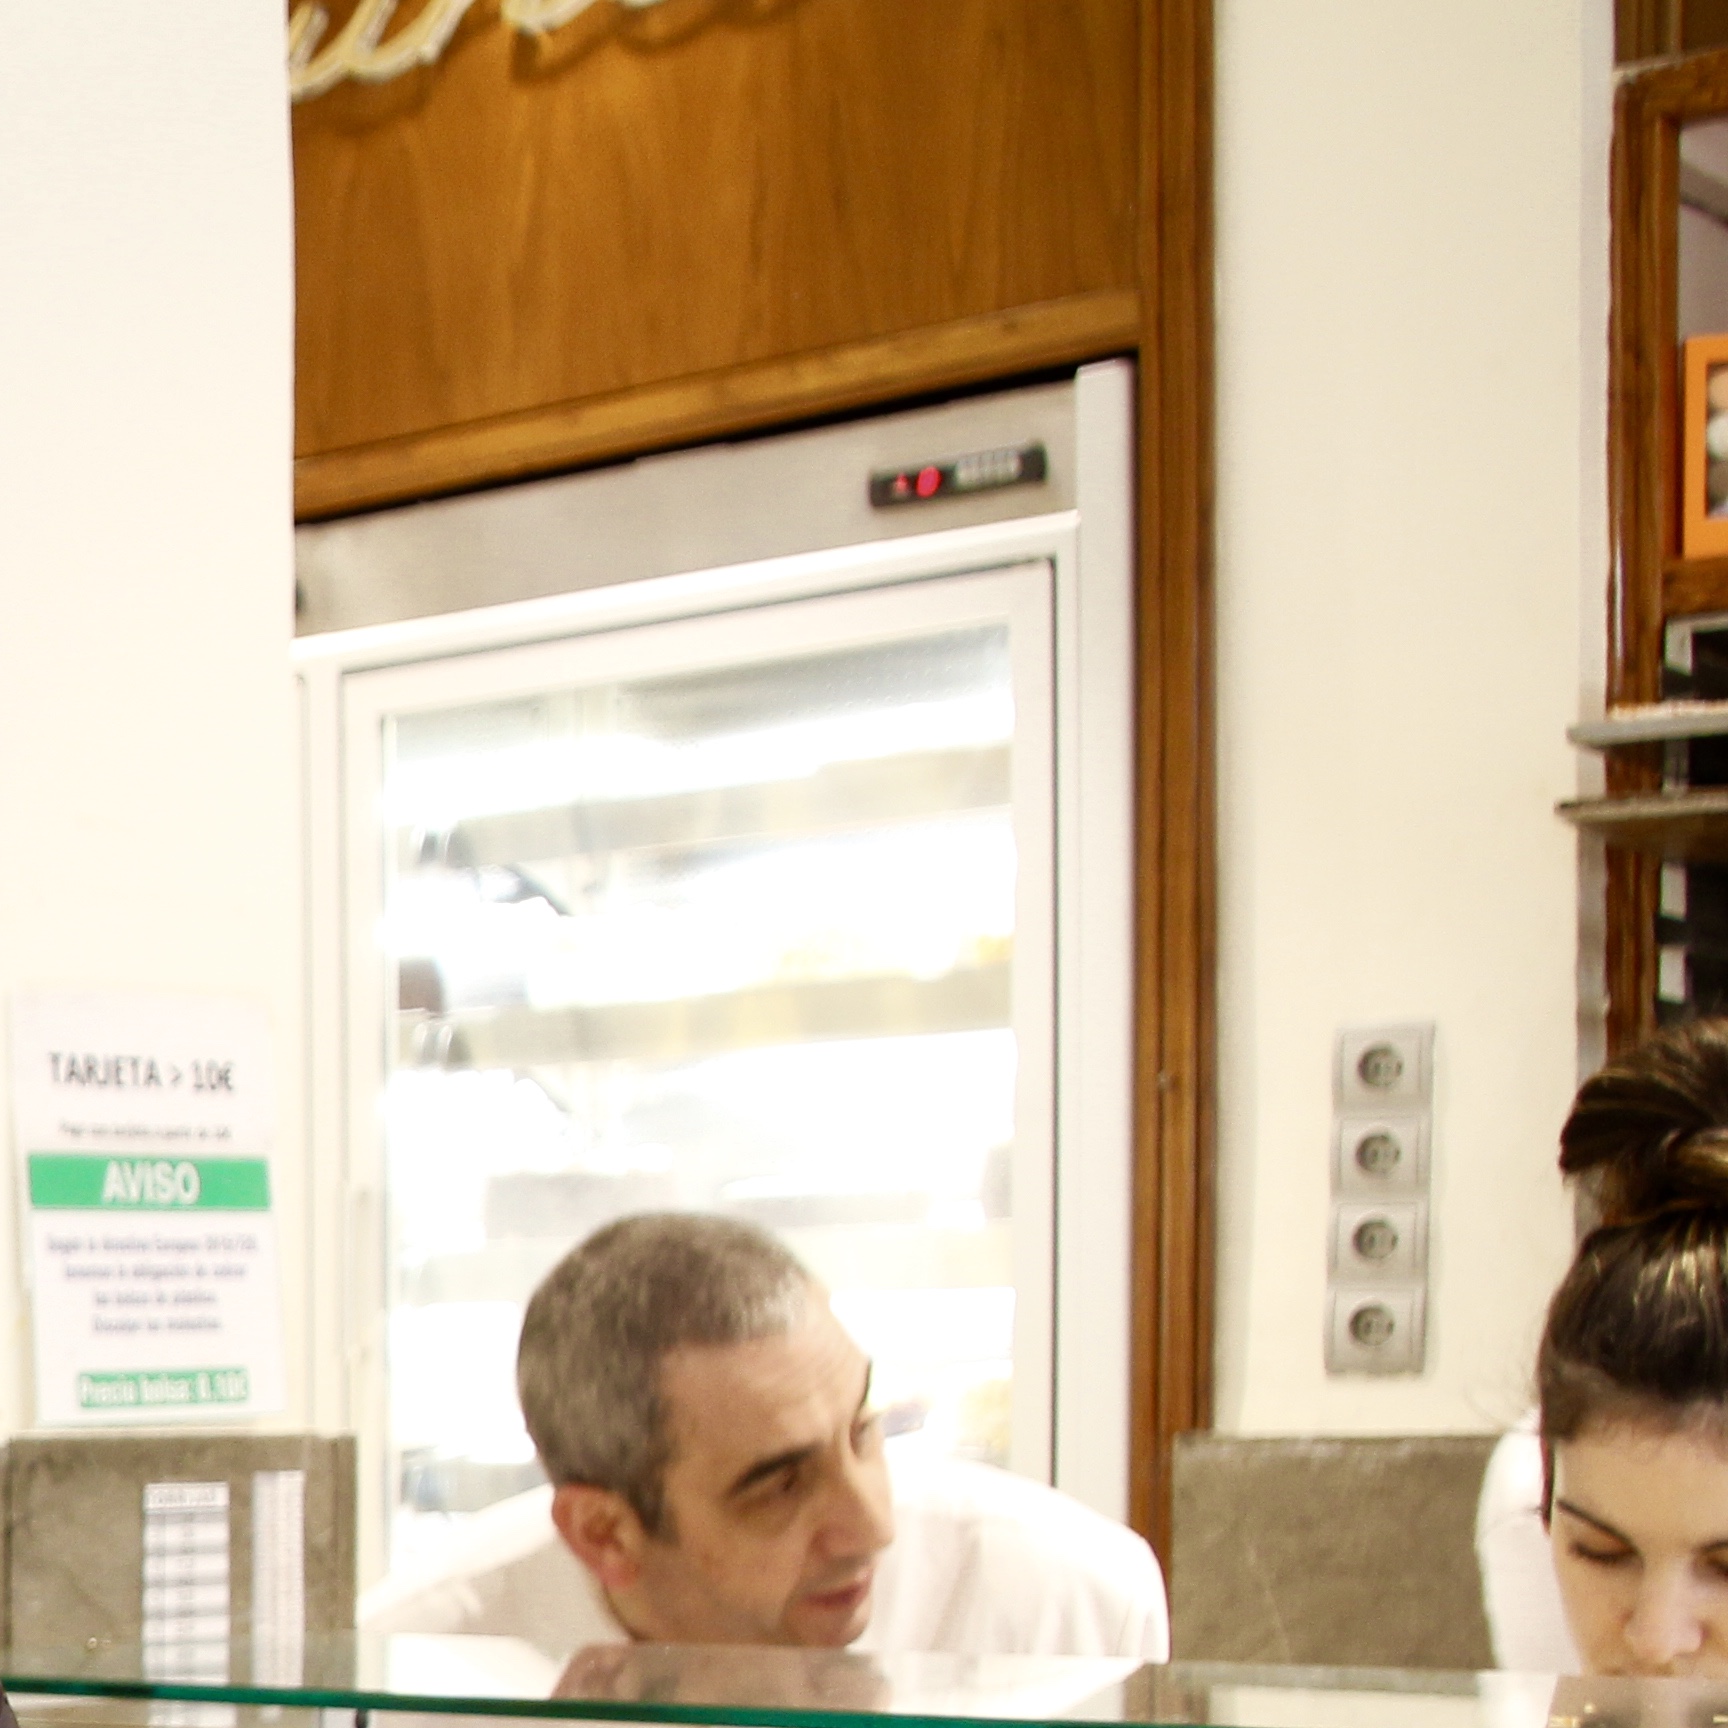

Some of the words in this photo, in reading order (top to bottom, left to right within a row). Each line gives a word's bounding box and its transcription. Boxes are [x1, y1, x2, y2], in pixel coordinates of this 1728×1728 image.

[48, 1051, 163, 1089] TARJETA
[192, 1058, 236, 1091] 10€
[101, 1159, 202, 1206] AVISO
